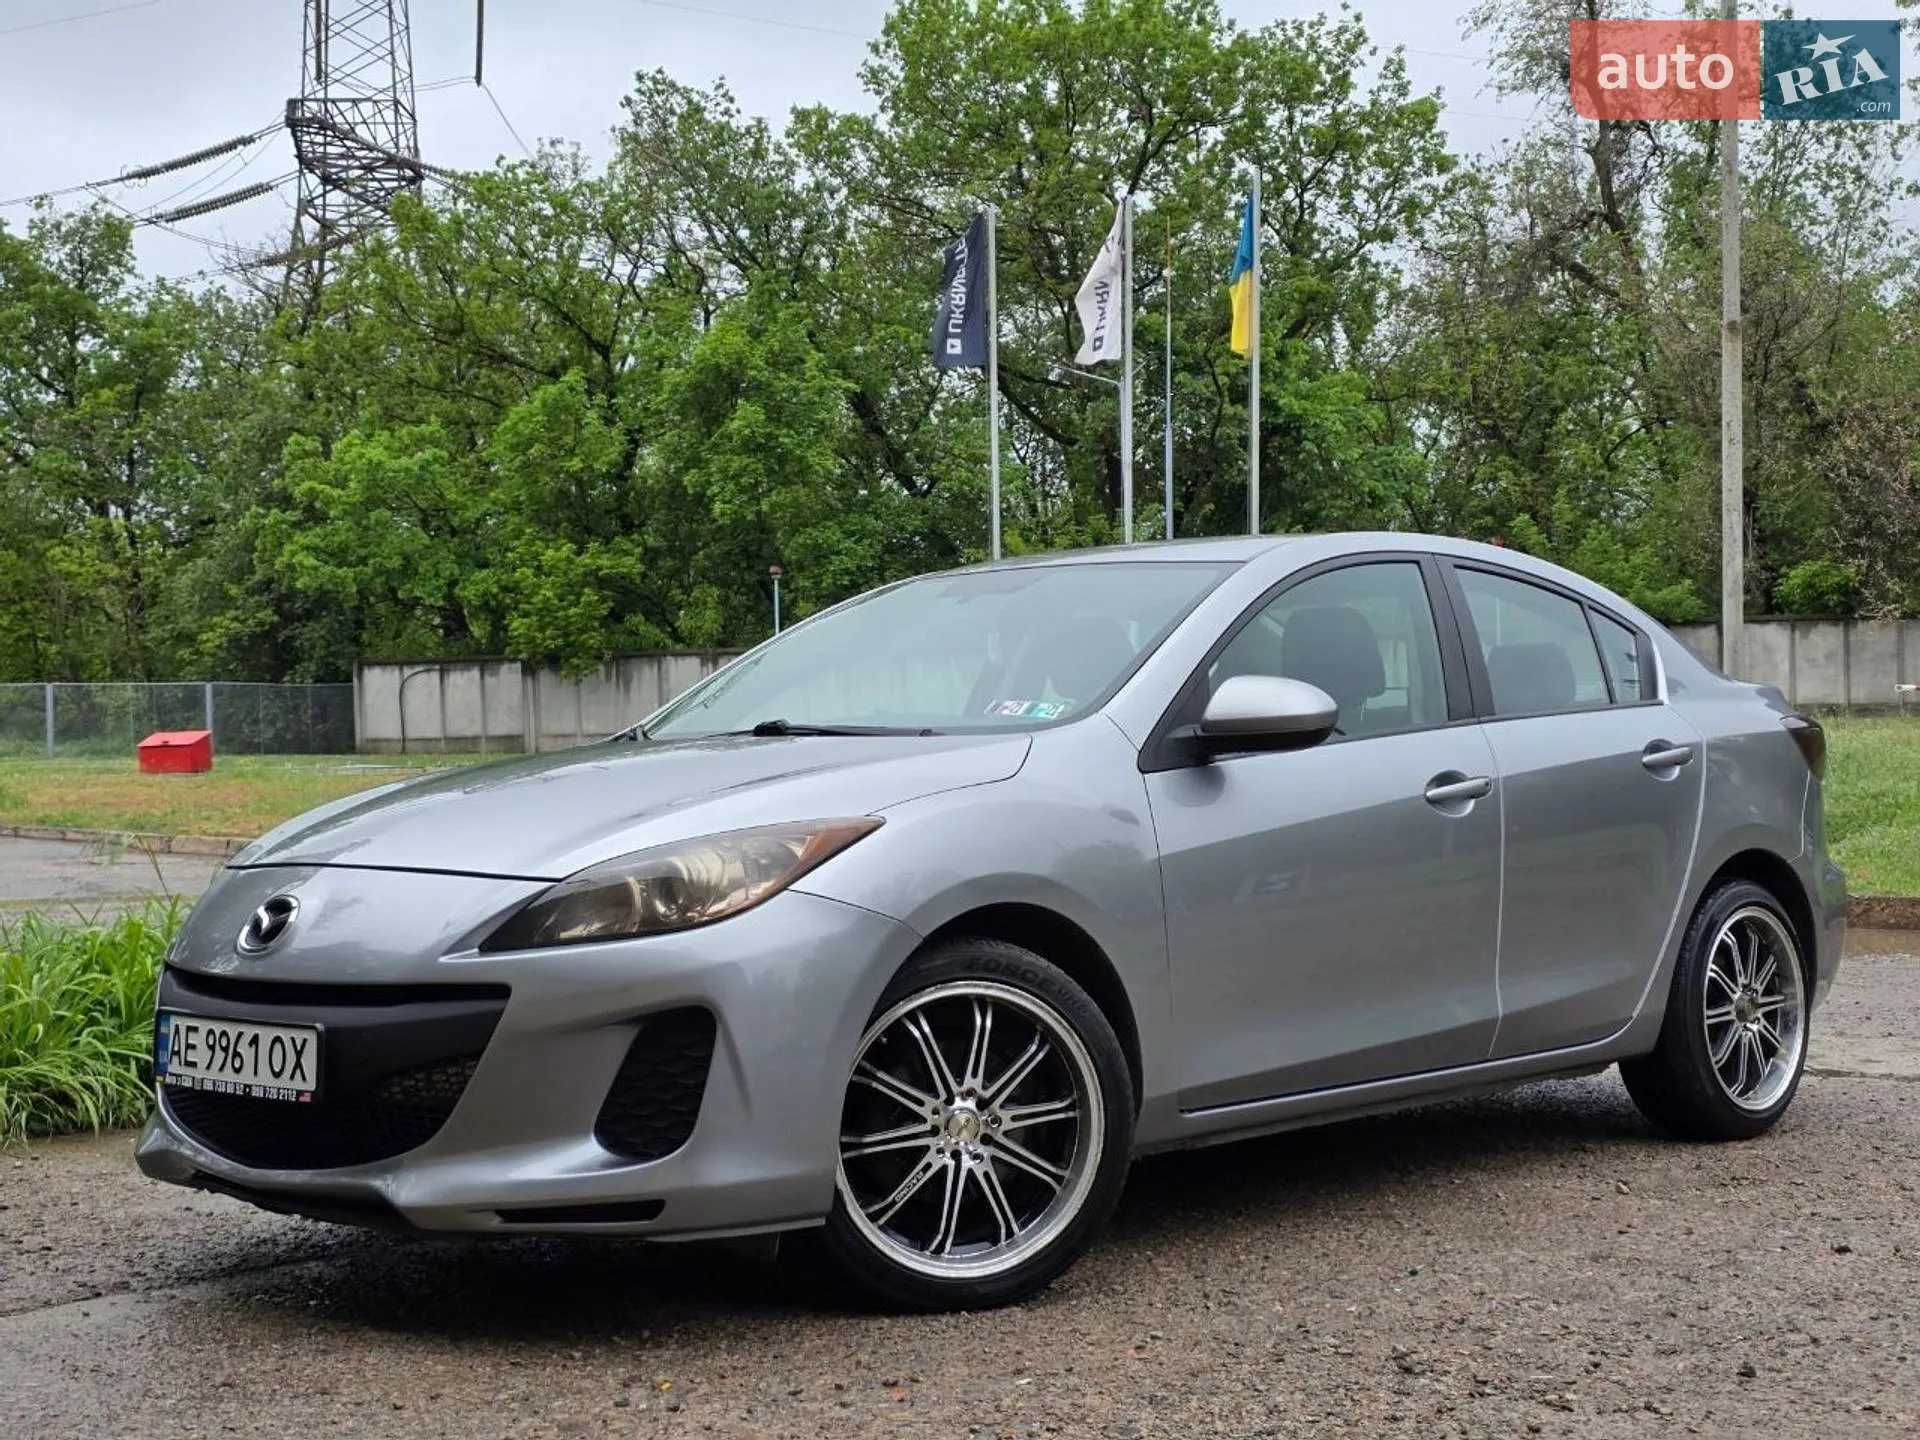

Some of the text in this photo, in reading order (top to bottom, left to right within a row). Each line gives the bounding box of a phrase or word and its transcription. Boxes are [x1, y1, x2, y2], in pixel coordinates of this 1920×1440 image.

[169, 1023, 308, 1083] AE 9961 OX
